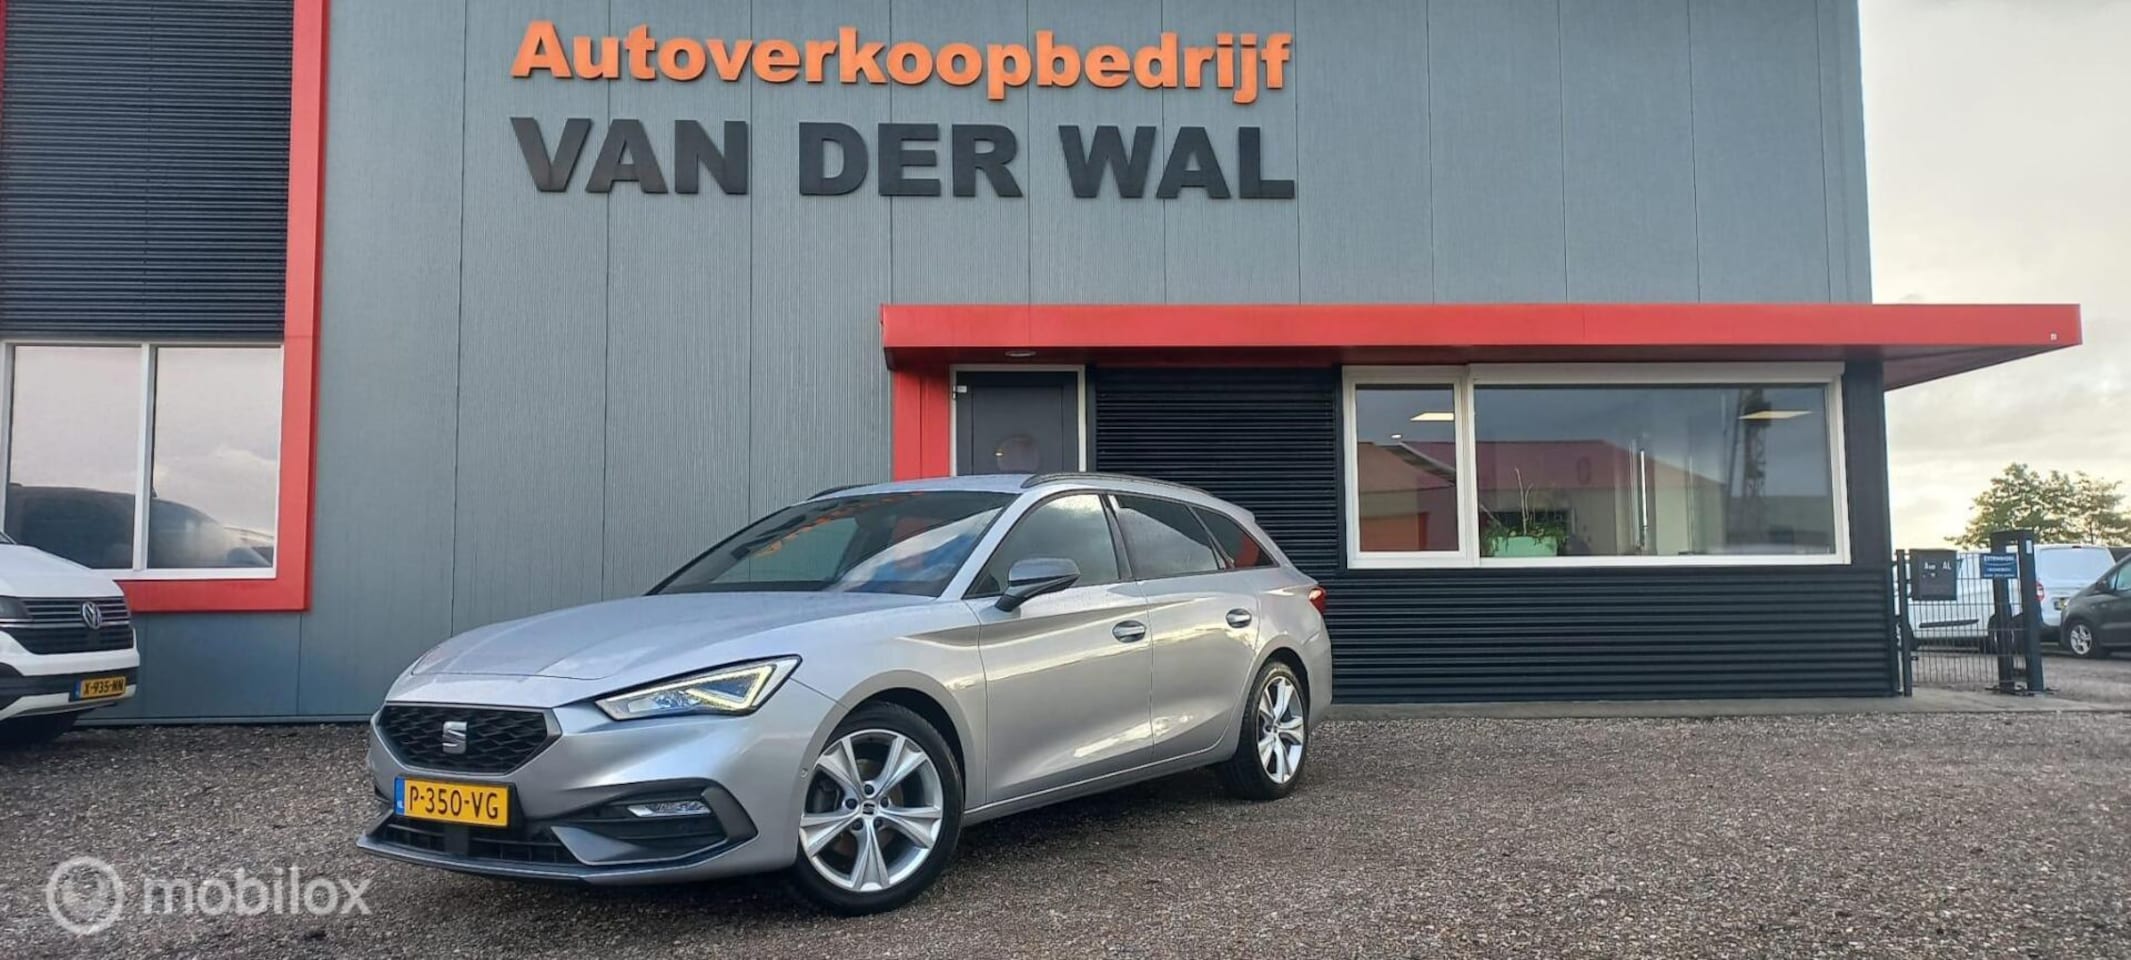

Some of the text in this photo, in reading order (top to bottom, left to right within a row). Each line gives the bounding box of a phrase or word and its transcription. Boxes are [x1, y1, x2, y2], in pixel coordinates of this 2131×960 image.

[510, 20, 1293, 104] Autoverkoopbedrijf
[510, 117, 1295, 200] VAN DER WAL
[83, 679, 124, 696] X-935-NN
[408, 785, 499, 819] P-350-VG
